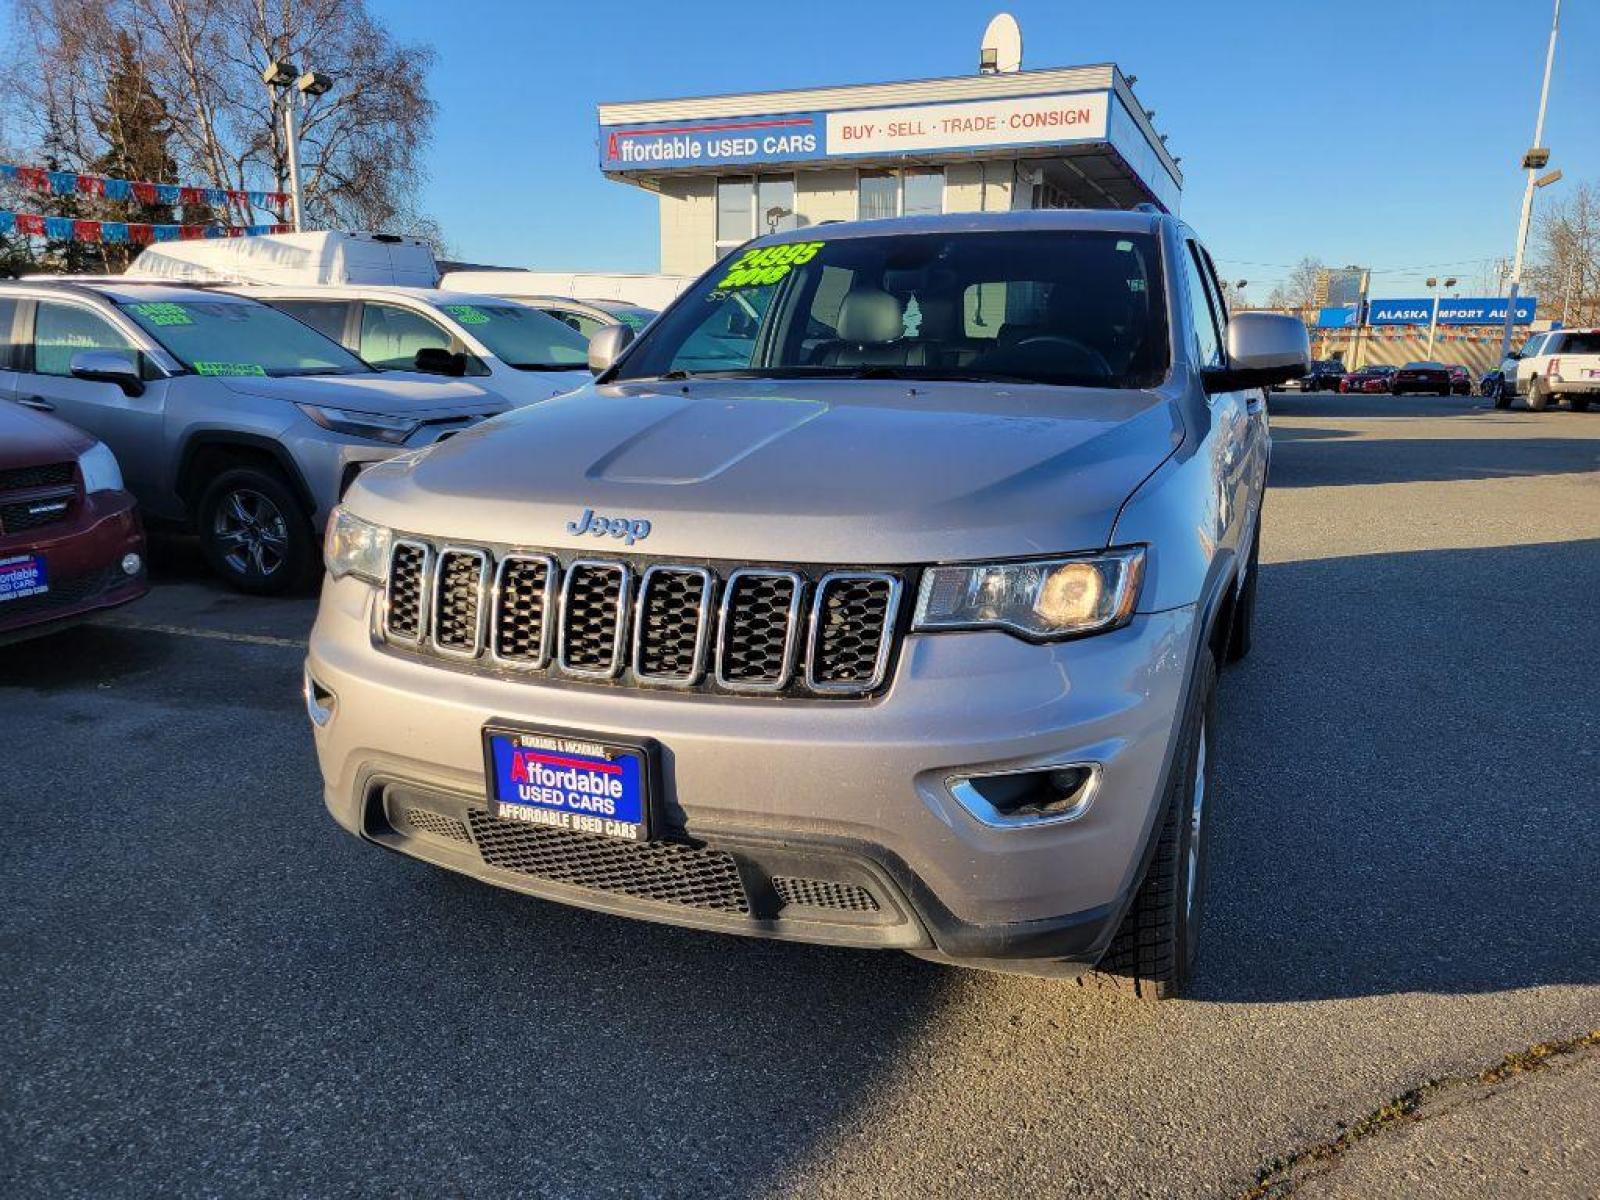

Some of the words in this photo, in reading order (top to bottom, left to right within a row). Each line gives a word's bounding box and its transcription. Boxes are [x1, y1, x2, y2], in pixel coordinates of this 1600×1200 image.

[843, 124, 875, 140] BUY
[887, 122, 926, 138] SELL
[941, 116, 997, 134] TRADE
[1010, 108, 1091, 129] CONSIGN
[607, 131, 702, 163] Affordable
[706, 138, 757, 158] USED
[763, 133, 817, 154] CARS
[1376, 309, 1429, 320] ALASKA
[1437, 309, 1484, 319] MPORT
[1488, 308, 1528, 319] AUO
[567, 506, 652, 546] Jeep
[511, 751, 623, 798] Affordable
[518, 783, 565, 805] USED
[568, 791, 616, 815] CARS
[499, 803, 570, 828] AFFORDABLE
[572, 815, 602, 834] USED
[605, 821, 637, 840] CARS
